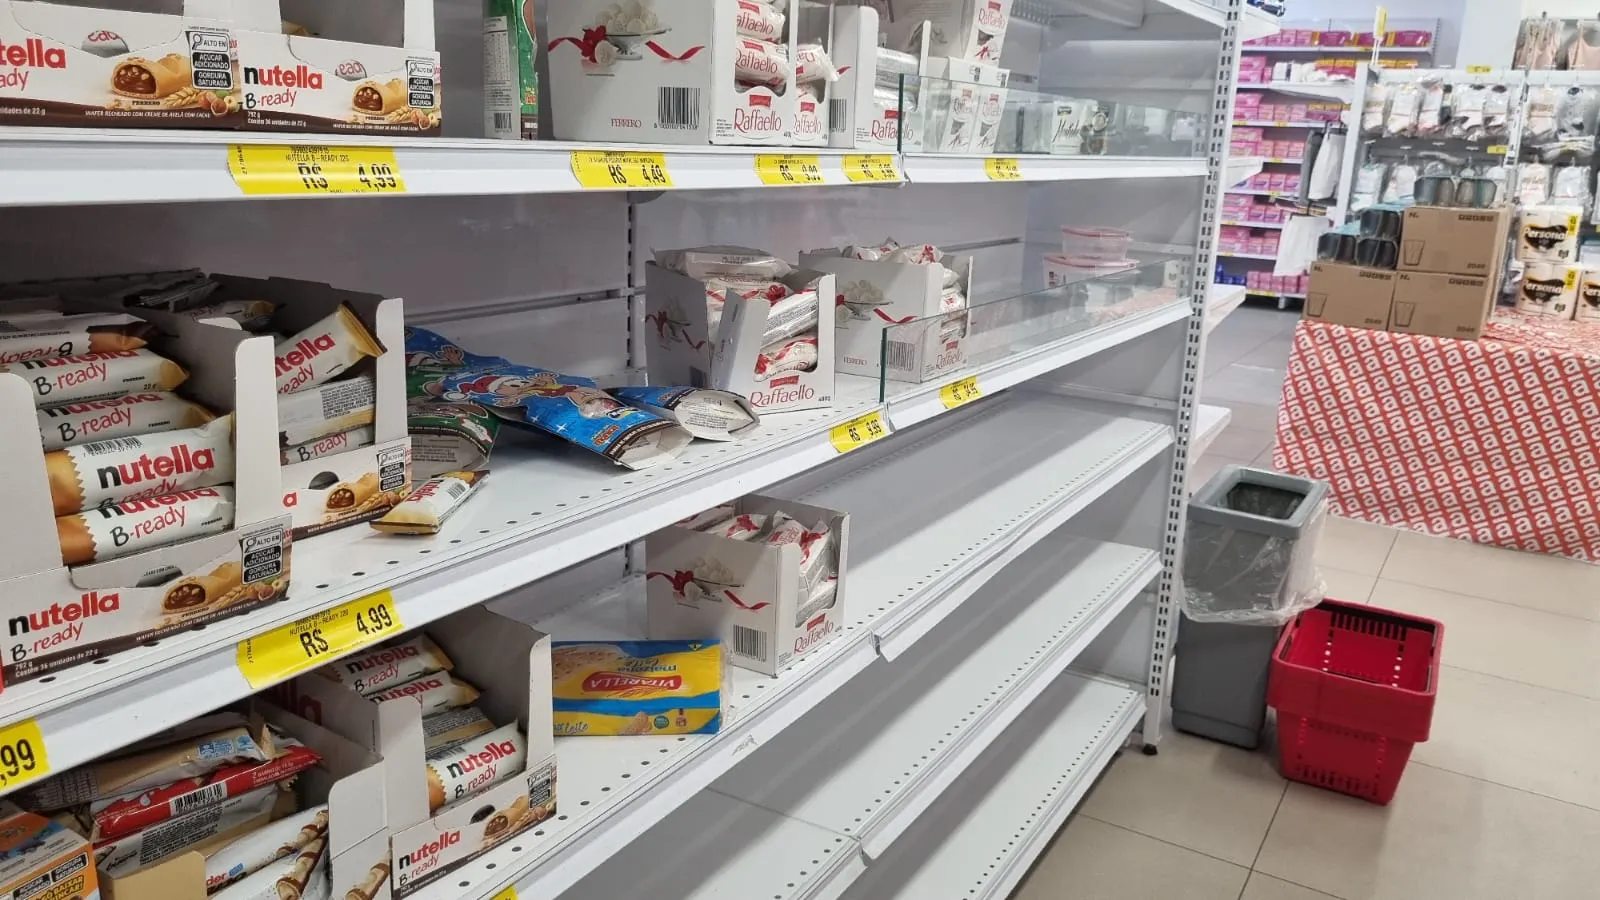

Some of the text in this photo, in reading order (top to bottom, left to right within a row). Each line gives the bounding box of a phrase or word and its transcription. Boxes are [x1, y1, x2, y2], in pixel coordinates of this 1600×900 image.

[736, 11, 774, 34] affaello
[244, 65, 323, 89] nutella
[245, 89, 297, 109] B-ready
[611, 118, 642, 128] FERRERO
[734, 108, 782, 133] Raffaello
[872, 120, 913, 141] Raffallo
[297, 162, 397, 191] R$ 4,99
[607, 164, 666, 185] R$ 4,49
[33, 362, 108, 396] B-ready
[750, 383, 815, 408] Raffaello
[57, 407, 131, 442] B-ready
[848, 428, 861, 443] R$
[297, 431, 347, 462] B-ready
[96, 444, 214, 489] nutella
[109, 505, 186, 547] B-ready
[257, 538, 271, 546] ALTO
[9, 591, 120, 636] nutella
[10, 621, 83, 662] B-ready
[299, 603, 393, 658] R$ 4,99
[794, 620, 834, 655] Raffaello
[345, 644, 420, 674] nutella
[354, 663, 399, 693] B-ready
[369, 677, 443, 705] nutella
[590, 678, 675, 689] VITARELLA
[446, 739, 517, 778] nutella
[454, 764, 497, 799] B-ready
[399, 831, 460, 870] nutella
[207, 872, 227, 885] der
[399, 853, 439, 887] B-ready
